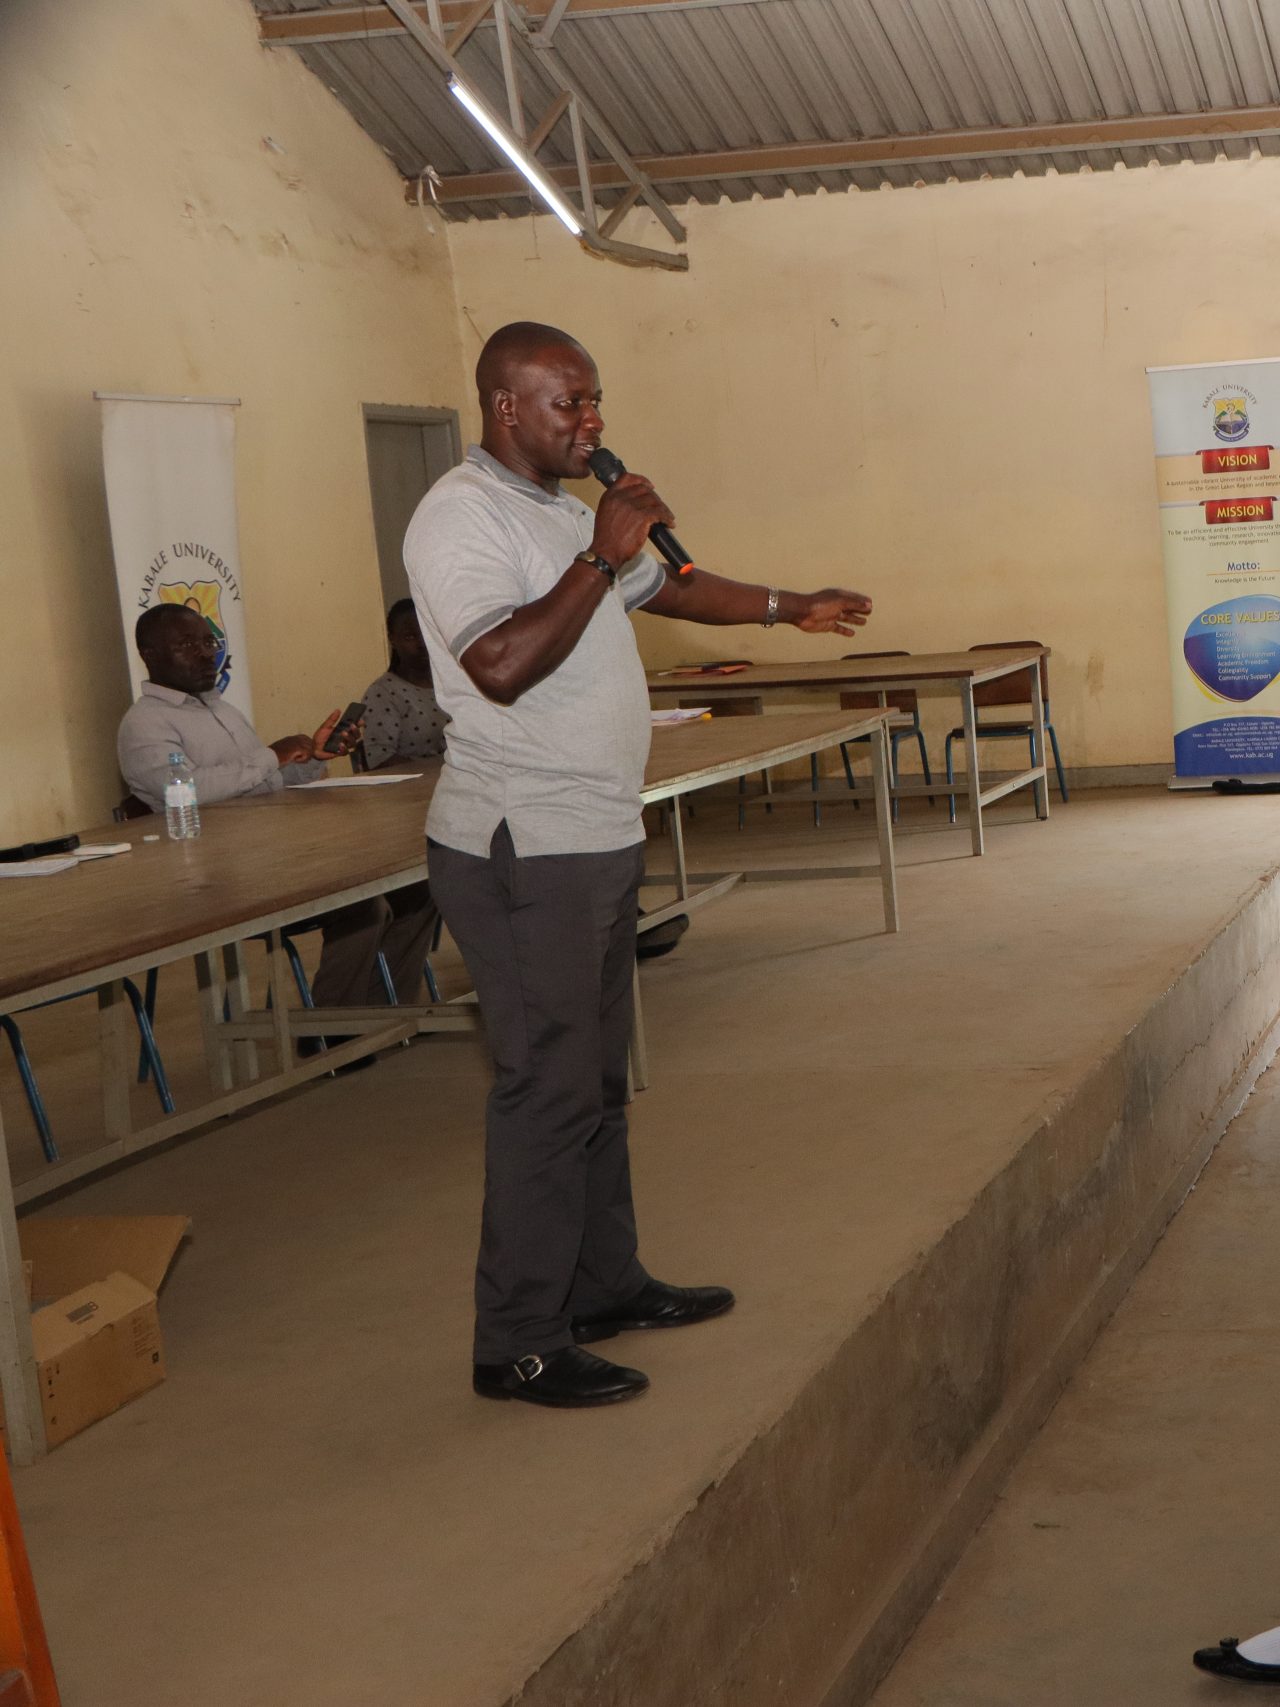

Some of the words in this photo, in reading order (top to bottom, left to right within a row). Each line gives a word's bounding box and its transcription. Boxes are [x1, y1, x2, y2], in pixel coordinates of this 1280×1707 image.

[1222, 383, 1258, 405] UNIVERSITY
[1218, 453, 1258, 467] VISION
[1220, 475, 1246, 484] University
[1216, 504, 1265, 518] MISSION
[1209, 540, 1237, 548] community
[1238, 538, 1269, 546] engagement
[1227, 561, 1261, 571] Motto:
[138, 550, 168, 609] KABALE
[172, 541, 242, 602] UNIVERSITY
[1201, 612, 1232, 625] CORE
[1236, 610, 1280, 623] VALUES
[1250, 673, 1272, 681] Support
[1229, 751, 1274, 760] www.kab.ac.ug
